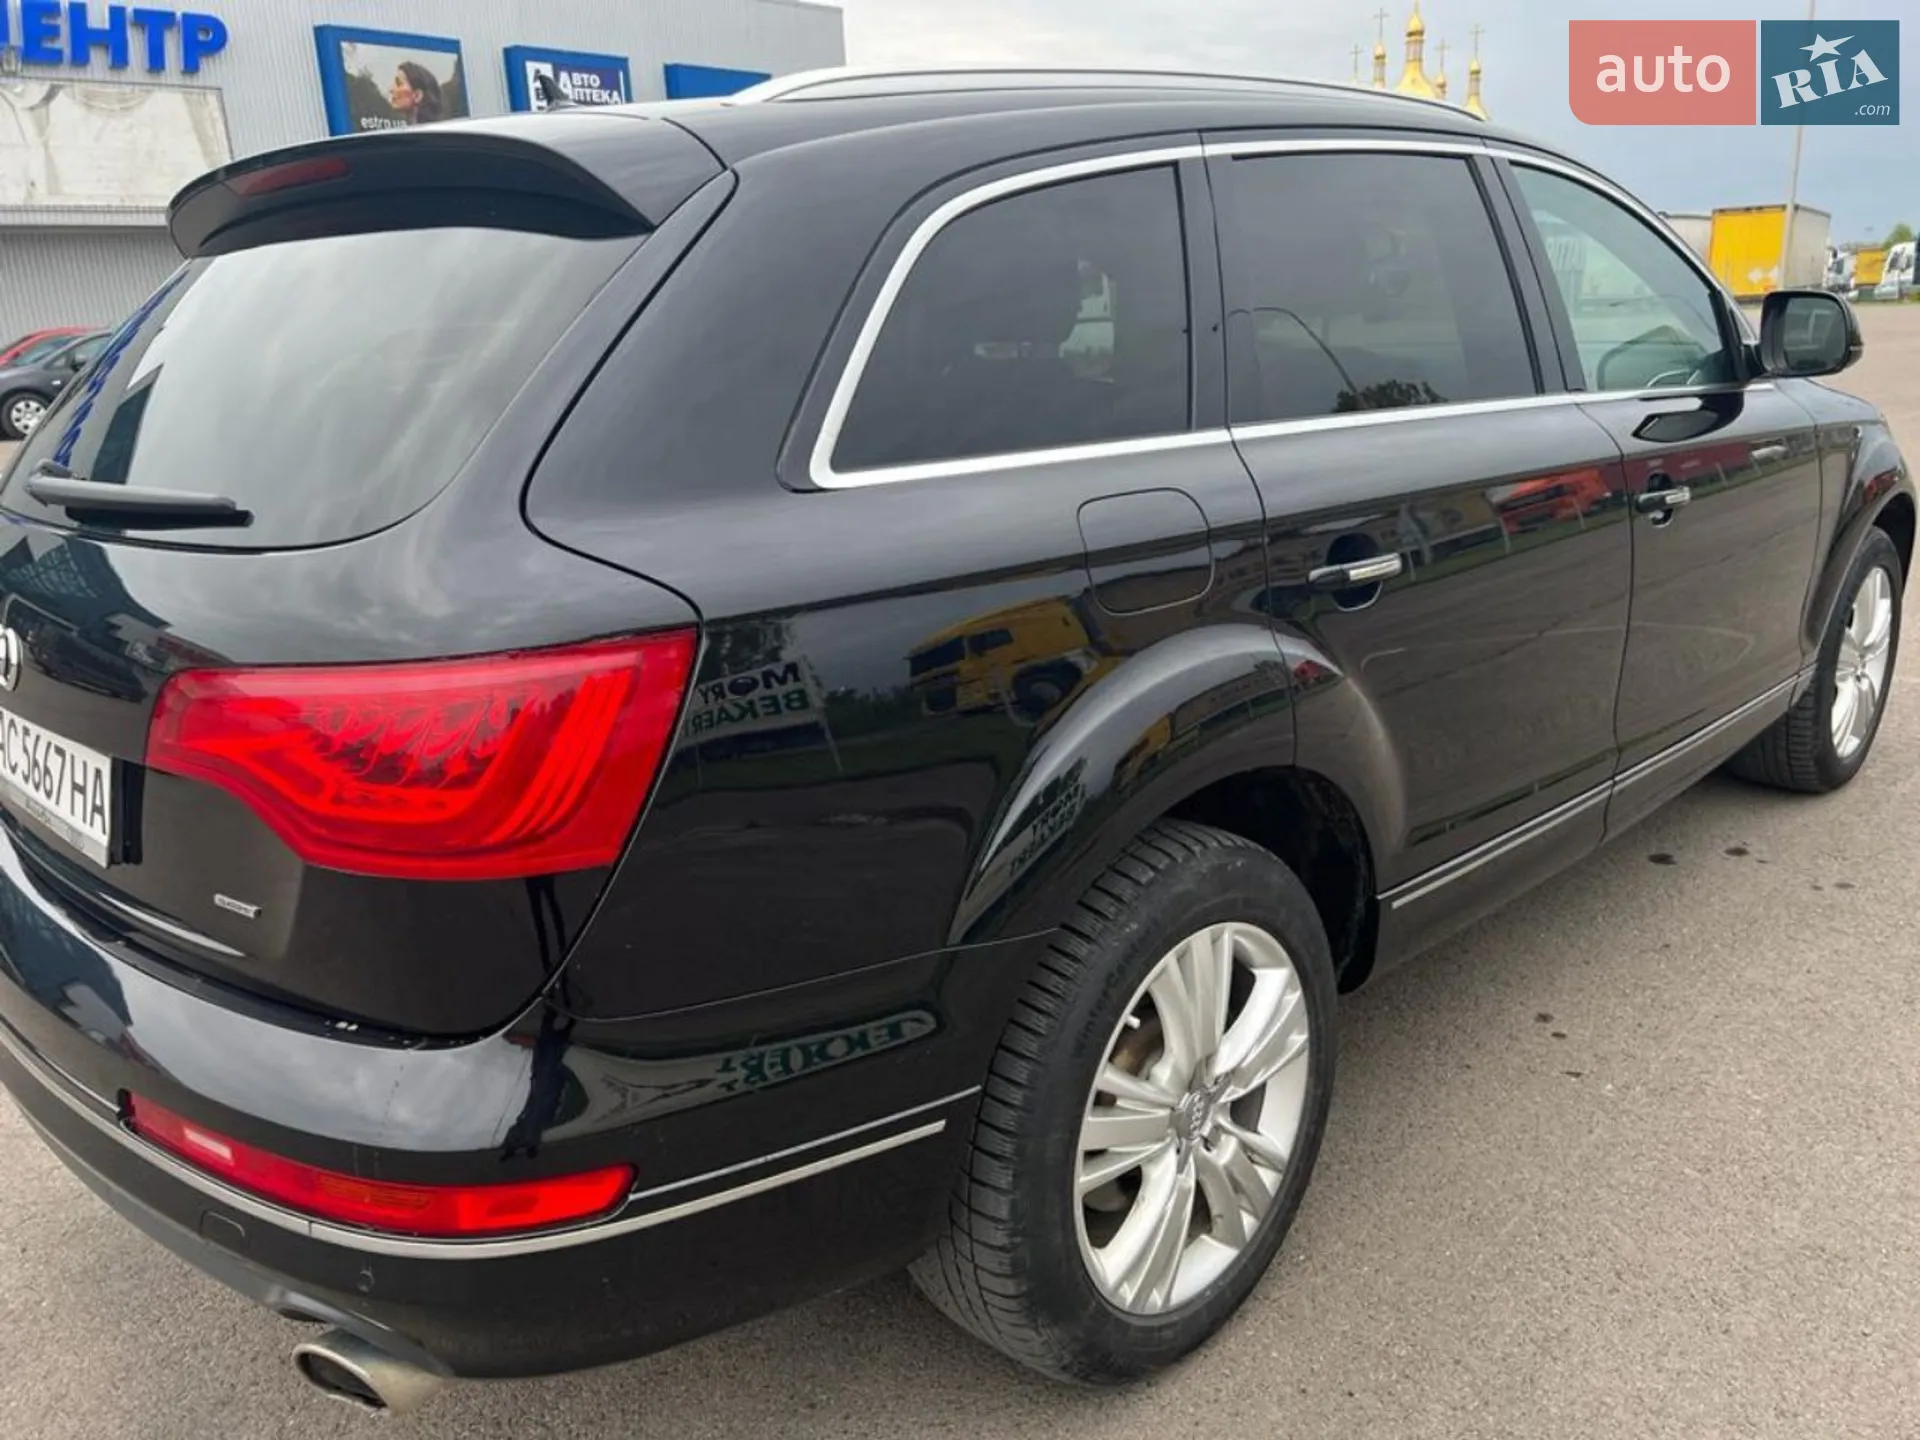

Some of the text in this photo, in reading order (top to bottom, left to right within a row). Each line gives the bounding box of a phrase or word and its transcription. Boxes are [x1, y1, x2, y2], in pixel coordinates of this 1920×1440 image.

[0, 0, 229, 74] ЕНТР
[21, 725, 68, 806] 5667
[70, 753, 108, 836] HA
